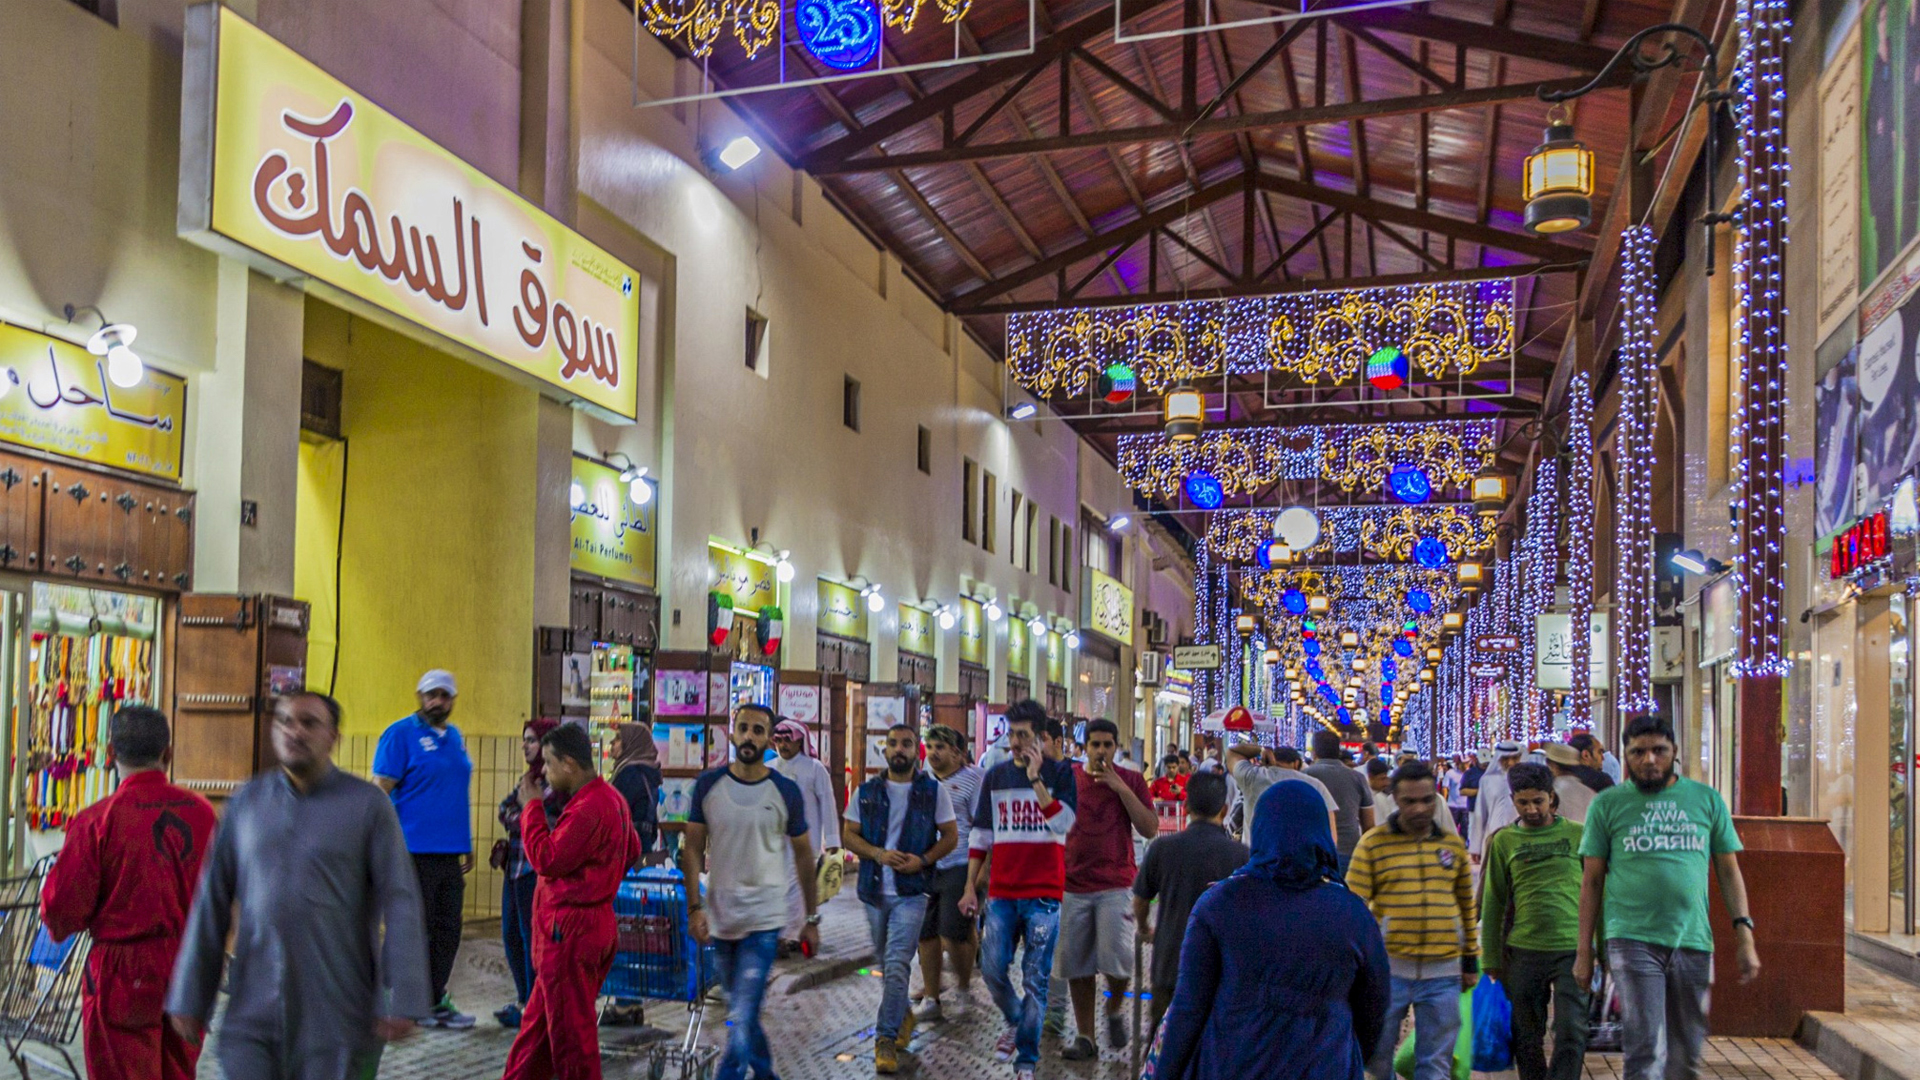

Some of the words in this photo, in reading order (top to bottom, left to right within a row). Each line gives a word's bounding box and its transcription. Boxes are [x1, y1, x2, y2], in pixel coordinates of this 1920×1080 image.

[254, 102, 488, 327] السمك
[513, 239, 619, 387] سوق
[28, 346, 172, 431] ساحل
[574, 537, 597, 554] Al-Tai
[600, 543, 633, 564] Perfumes
